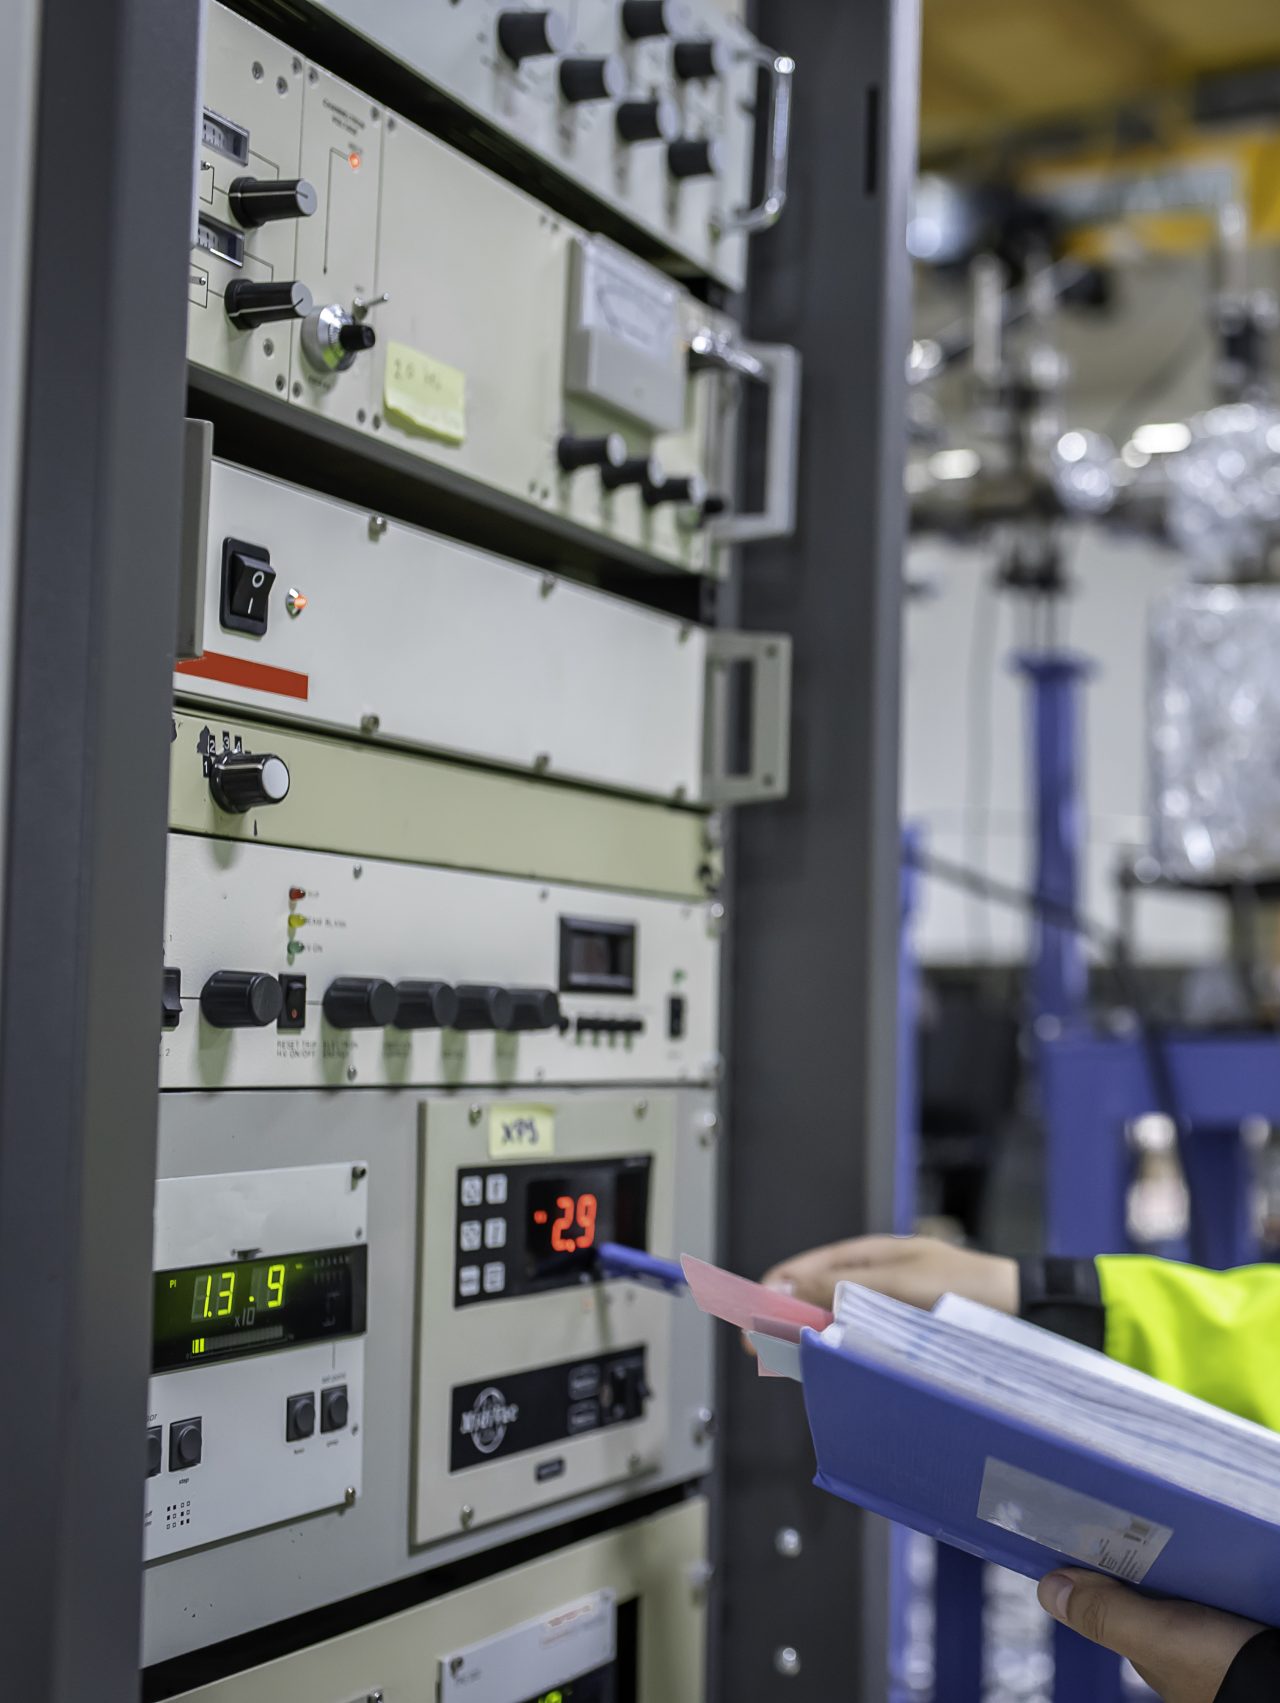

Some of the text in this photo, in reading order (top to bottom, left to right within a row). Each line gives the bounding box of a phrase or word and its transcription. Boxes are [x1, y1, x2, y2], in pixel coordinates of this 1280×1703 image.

[210, 740, 216, 753] 2
[224, 737, 230, 749] 3
[204, 761, 208, 774] 1
